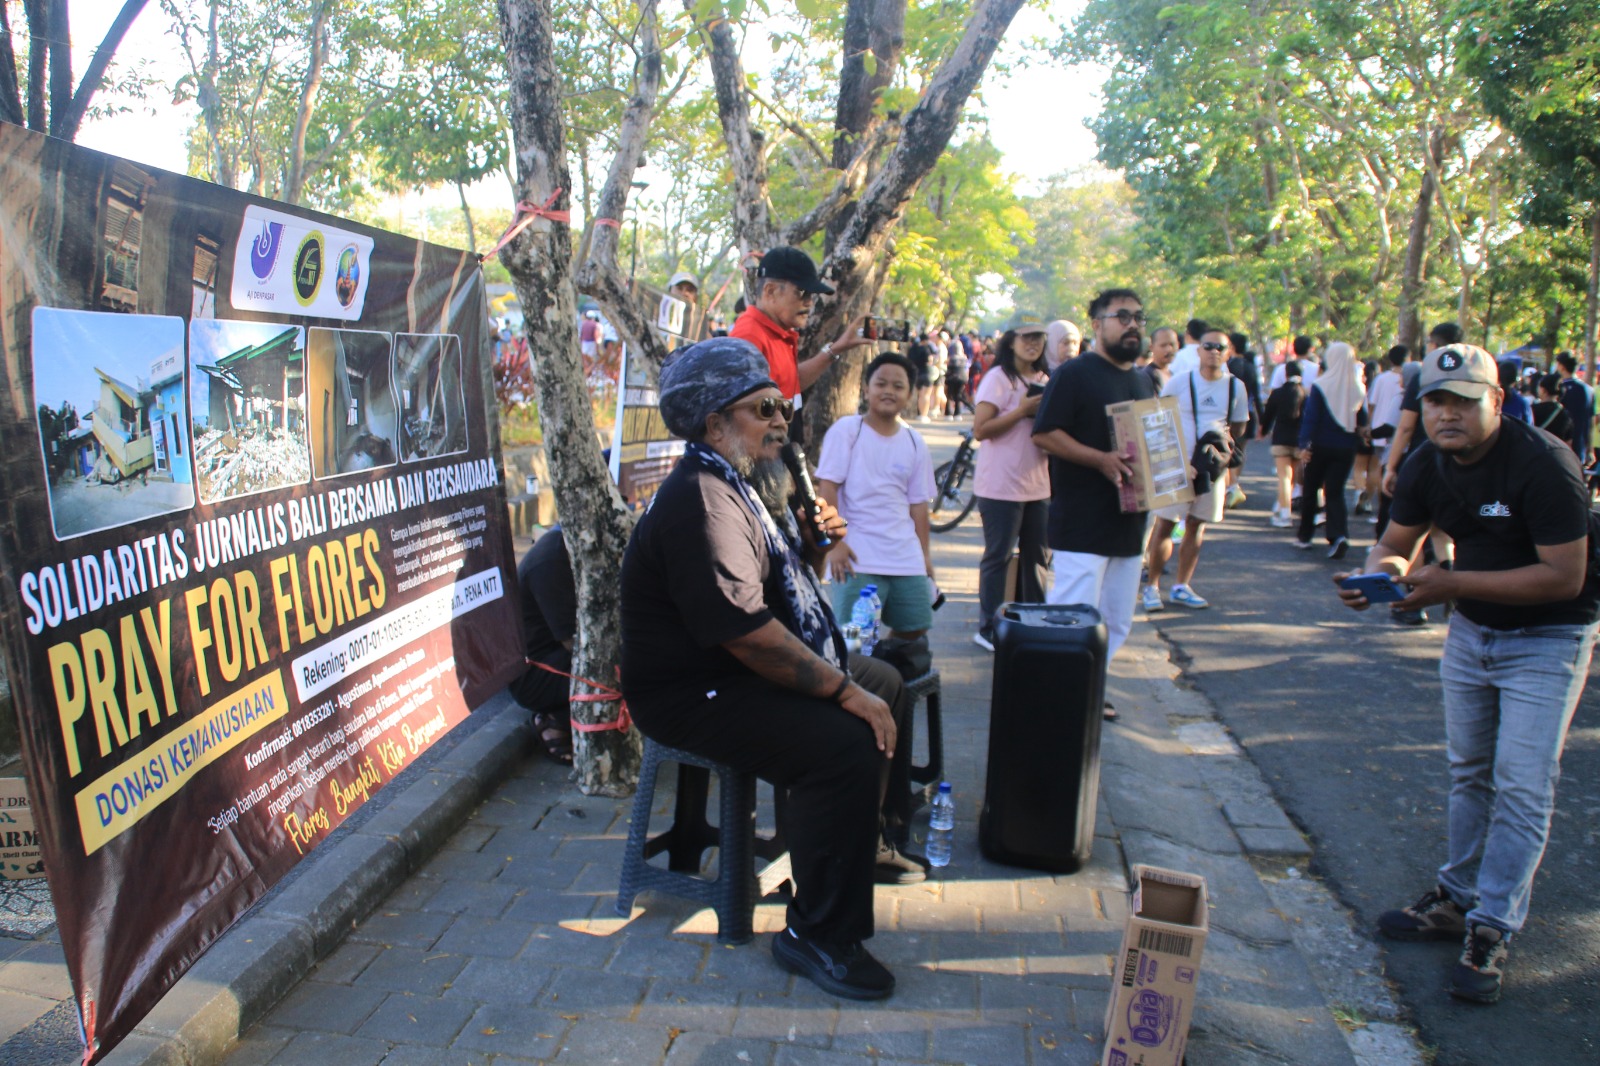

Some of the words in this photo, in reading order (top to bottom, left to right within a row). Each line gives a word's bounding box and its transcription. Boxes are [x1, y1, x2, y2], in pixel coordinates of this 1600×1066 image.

[20, 528, 189, 635] SOLIDARITAS
[193, 506, 288, 573] JURNALIS
[288, 493, 327, 541] BALI
[328, 477, 397, 529] BERSAMA
[397, 469, 425, 510] DAN
[426, 457, 499, 503] BERSAUDARA
[391, 527, 408, 541] Gempa
[408, 521, 420, 536] bumi
[420, 517, 432, 532] telah
[432, 511, 462, 528] mengguncang
[462, 507, 476, 519] Flores
[475, 505, 486, 518] yang
[393, 537, 428, 559] mengakibatkan
[428, 530, 442, 547] rumah
[442, 528, 456, 541] warga
[395, 555, 422, 575] terdampak,
[421, 551, 431, 566] dan
[430, 545, 447, 562] banyak
[446, 541, 464, 557] saudara
[463, 538, 473, 551] kita
[472, 535, 483, 550] yang
[397, 569, 430, 593] membutuhkan
[429, 563, 448, 580] bantuan
[48, 598, 178, 778] PRAY
[185, 569, 270, 697] FOR
[269, 528, 387, 653] FLORES
[303, 650, 348, 689] Rekening:
[464, 584, 483, 605] PENA
[483, 575, 498, 597] NTT
[95, 754, 169, 828] DONASI
[168, 685, 275, 776] KEMANUSIAAN
[236, 782, 270, 814] bantuan
[269, 767, 288, 791] anda
[287, 749, 312, 777] sangat
[307, 733, 331, 760] berarti
[328, 724, 346, 745] bagi
[344, 712, 367, 736] saudara
[364, 705, 377, 721] kita
[375, 698, 383, 714] di
[244, 727, 294, 771] Konfirmasi:
[292, 700, 336, 738] 0818353281
[337, 679, 373, 709] Agustinus
[267, 781, 306, 818] ringankan
[302, 765, 326, 788] beban
[324, 748, 349, 774] mereka
[346, 740, 360, 756] dan
[284, 807, 330, 855] Flores
[330, 755, 381, 815] Bangkit
[377, 737, 406, 775] Kita
[401, 704, 448, 754] Bersama!
[1131, 991, 1161, 1047] Daia
